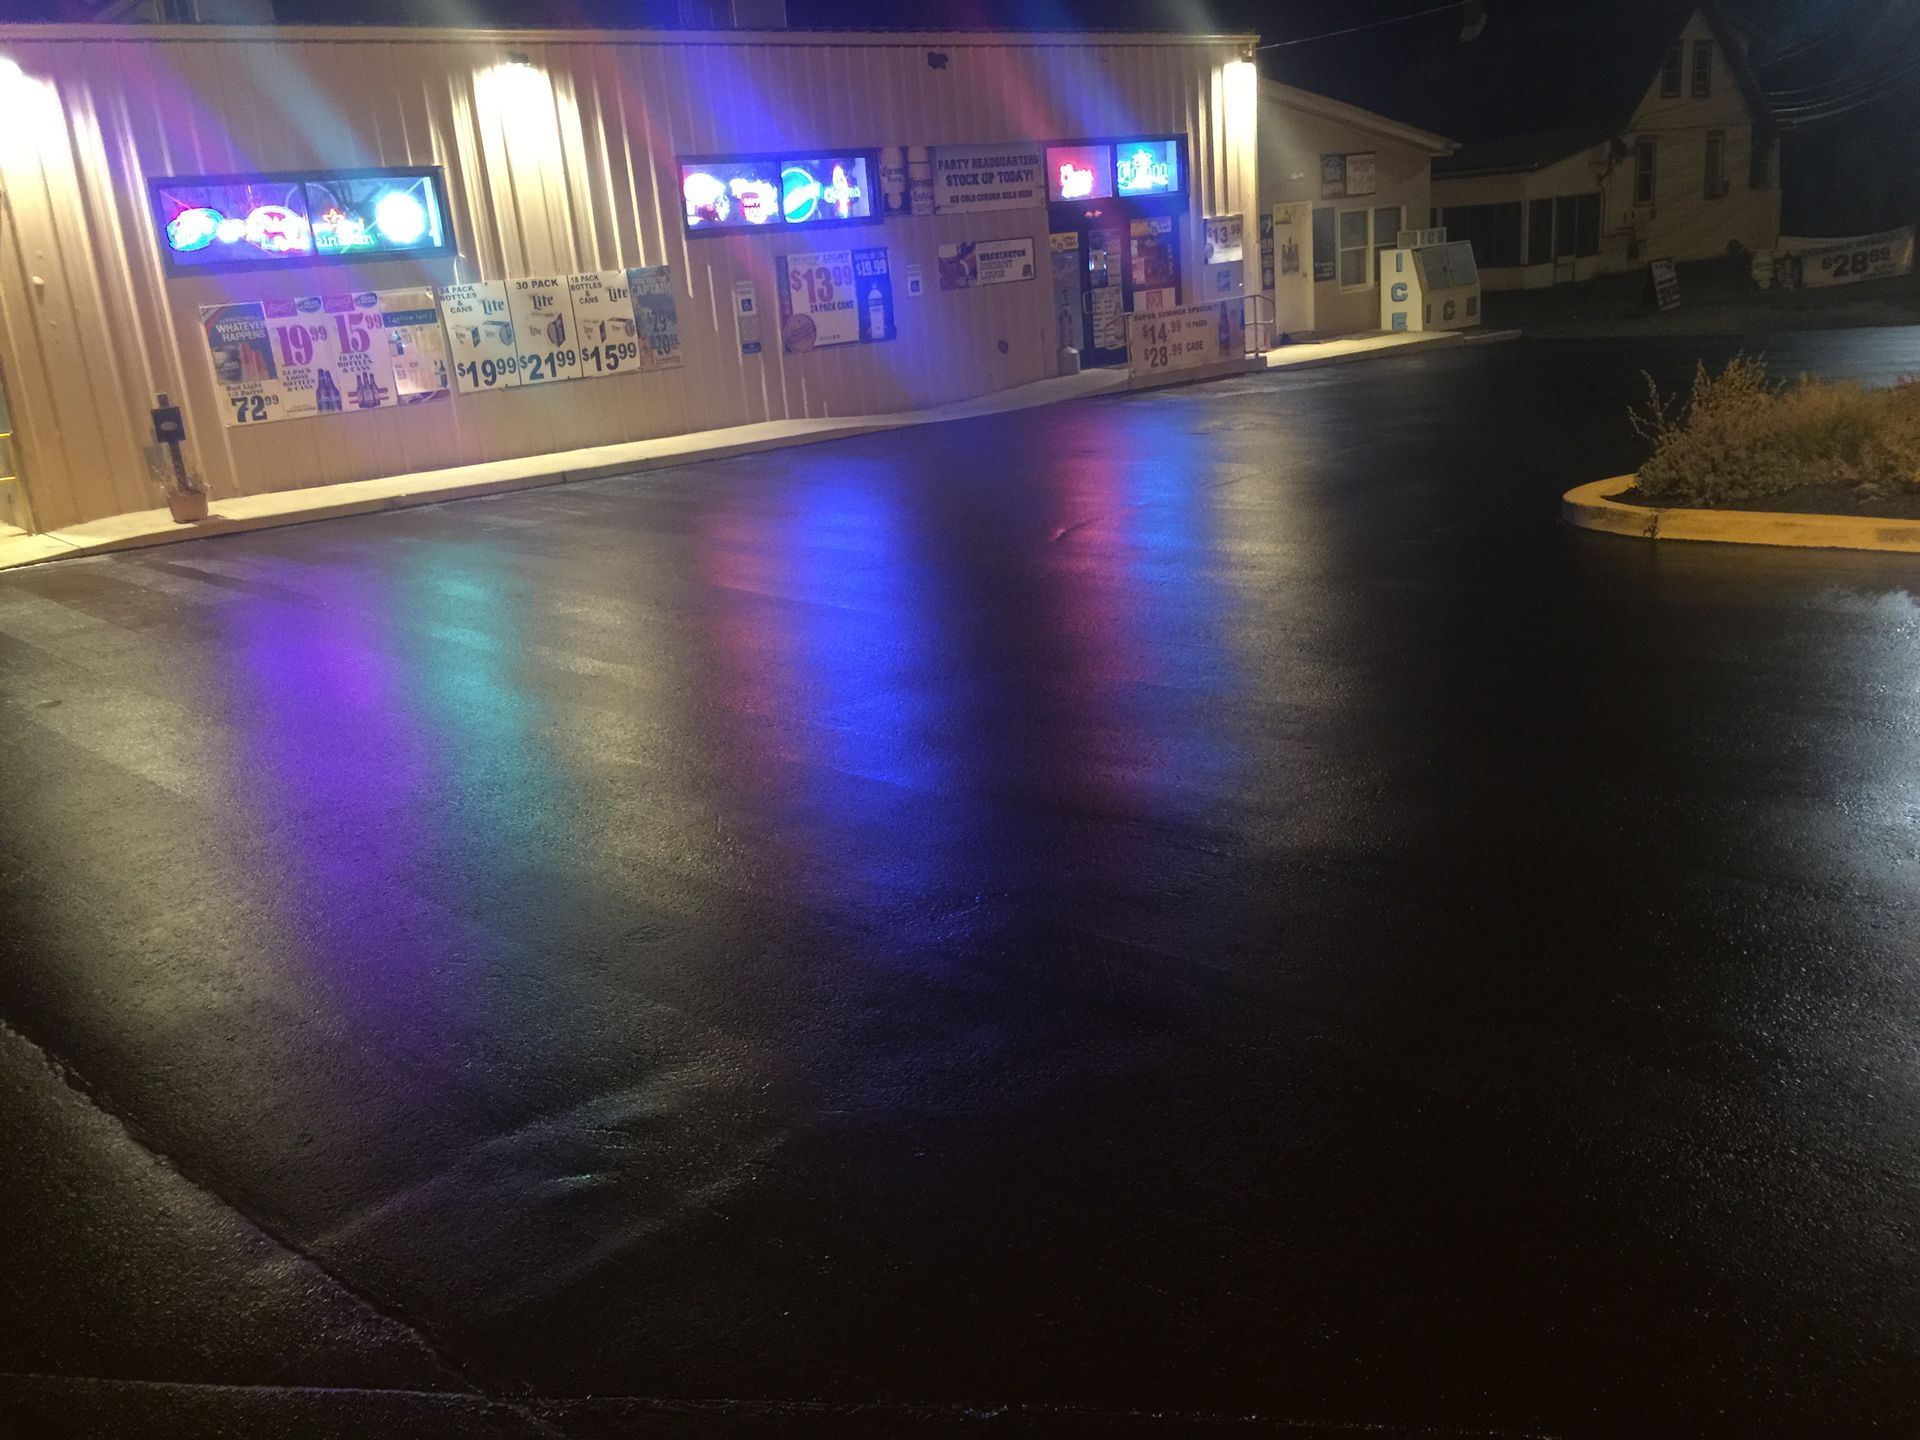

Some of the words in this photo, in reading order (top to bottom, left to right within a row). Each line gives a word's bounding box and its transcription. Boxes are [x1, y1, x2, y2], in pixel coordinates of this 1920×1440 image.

[938, 158, 969, 170] PARTY
[971, 155, 1039, 169] HEADQUARTERS
[946, 173, 980, 187] STOCK
[981, 172, 995, 184] UP
[997, 170, 1034, 183] TODAY!
[1207, 223, 1240, 244] $13.99
[452, 285, 474, 293] PACK
[516, 281, 528, 290] 30
[531, 279, 558, 288] PACK
[570, 281, 602, 291] BOTTLES
[1391, 252, 1408, 331] ICE
[440, 292, 477, 301] BOTTLES
[579, 296, 599, 304] CANS
[607, 287, 629, 302] Lite
[482, 299, 505, 315] Lite
[531, 295, 554, 310] Lite
[1426, 295, 1478, 324] ICE
[216, 321, 265, 333] WHATEVER
[1142, 320, 1182, 344] $14.99
[222, 330, 266, 342] HAPPENS
[1143, 343, 1182, 368] $28.99
[1186, 340, 1204, 352] CASE
